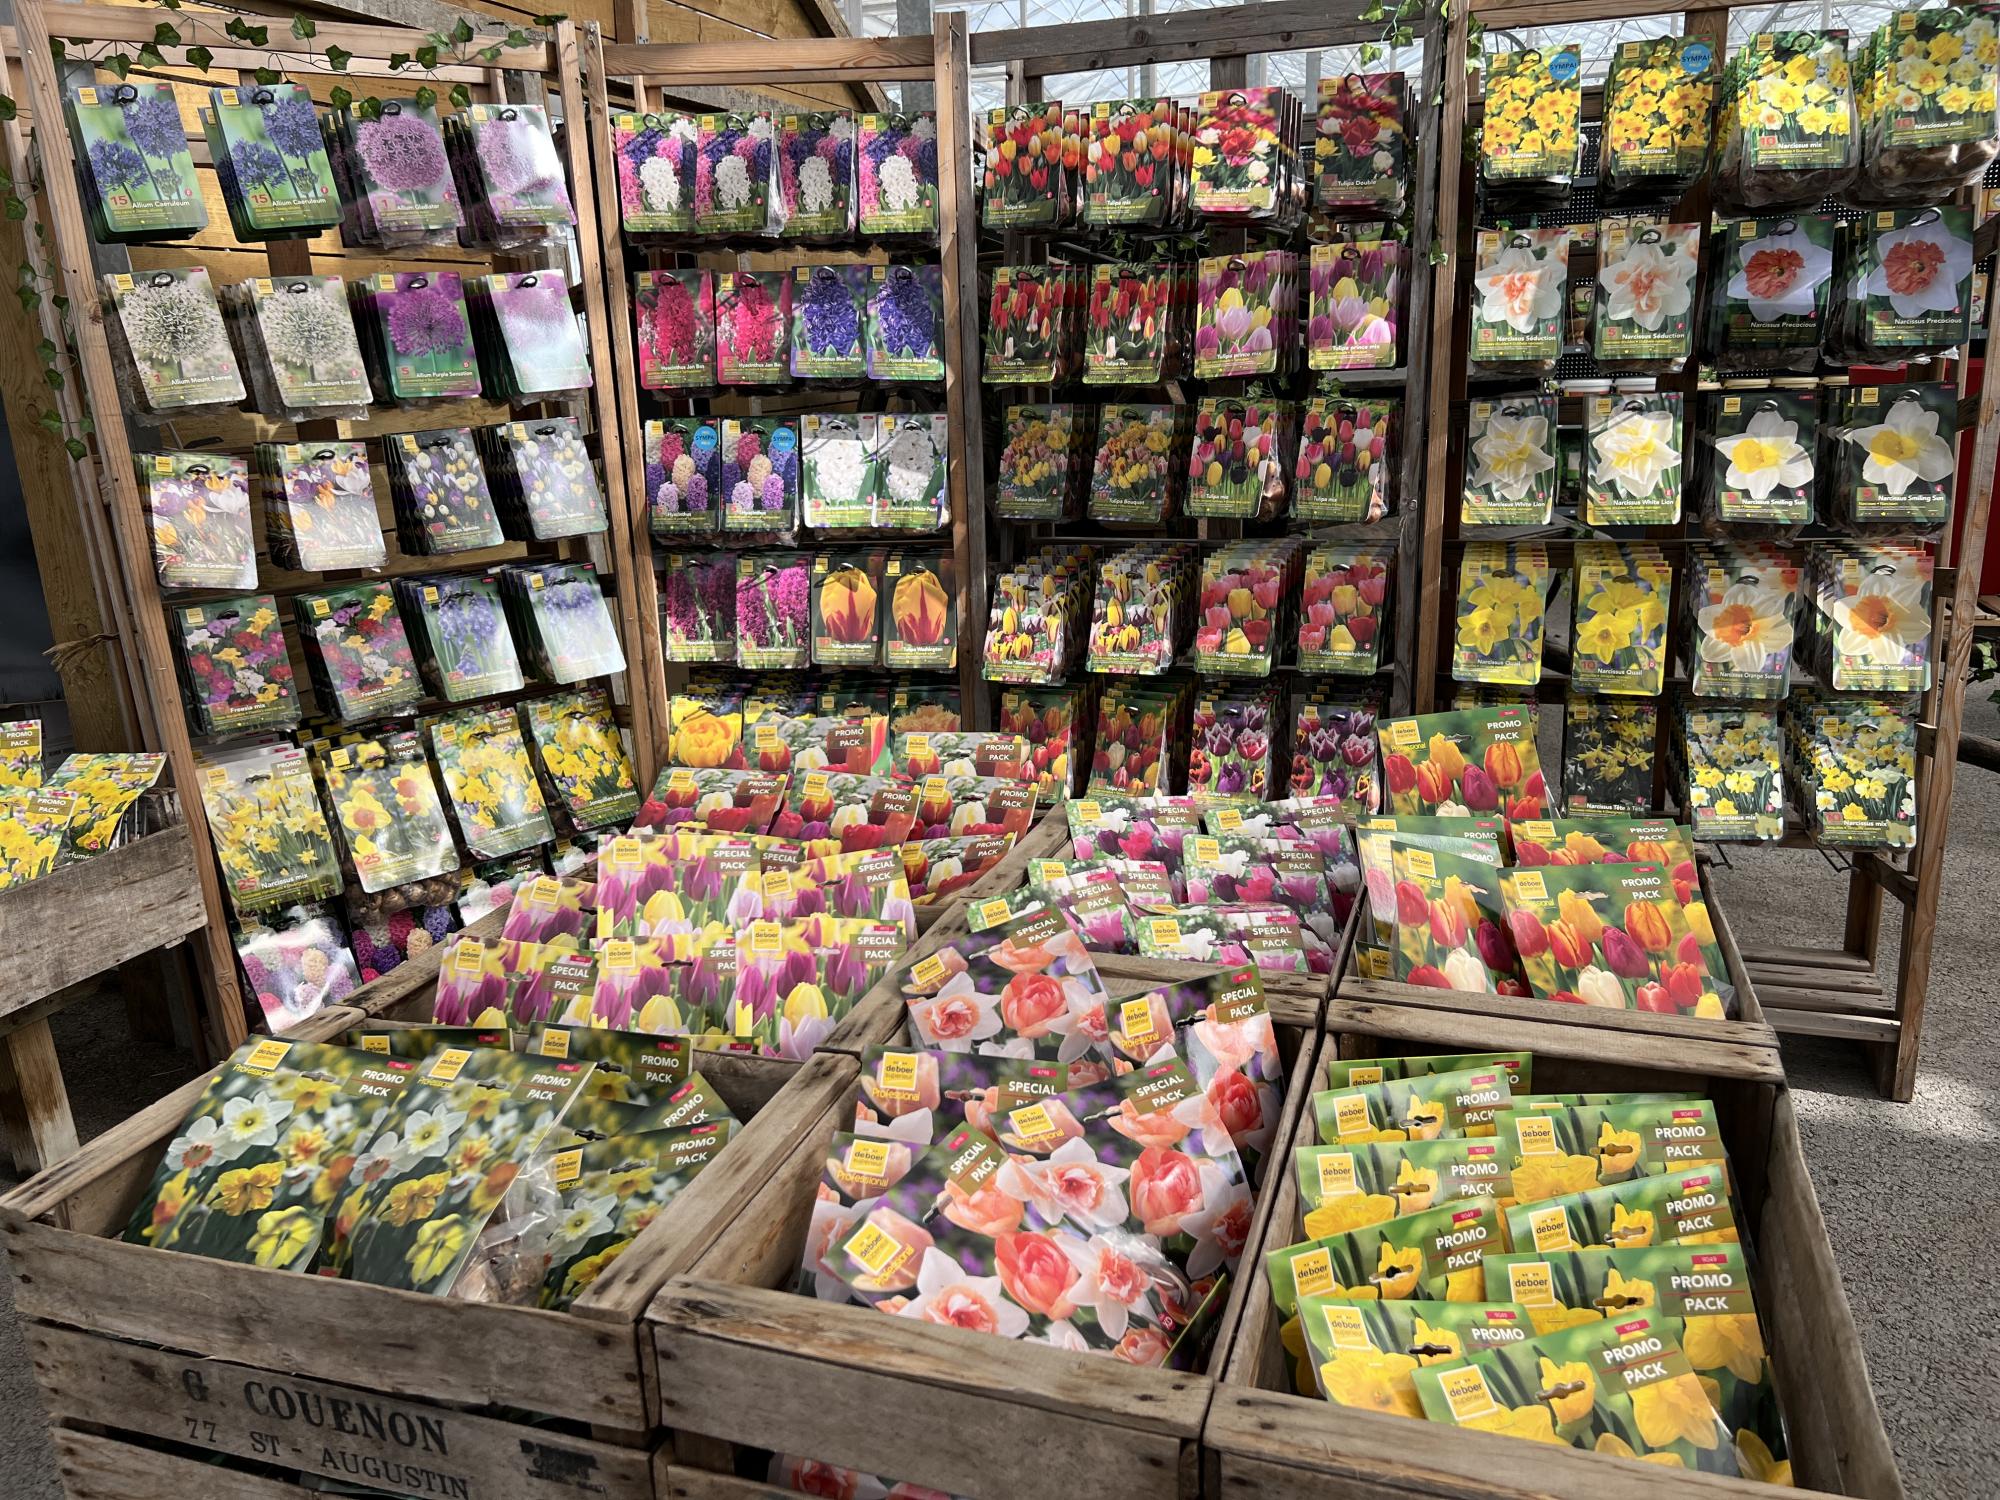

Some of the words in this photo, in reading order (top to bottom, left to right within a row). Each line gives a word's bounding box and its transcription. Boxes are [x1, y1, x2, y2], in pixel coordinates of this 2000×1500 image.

[110, 195, 128, 206] 15
[132, 201, 153, 209] Allium
[251, 194, 268, 204] 15
[1895, 317, 1925, 325] Narcissus
[1926, 317, 1962, 325] Precocious
[1525, 333, 1556, 341] Séduction
[1652, 331, 1685, 339] Séduction
[432, 371, 449, 379] Purple
[1908, 494, 1931, 502] Smiling
[1626, 668, 1643, 676] Quail
[1884, 664, 1904, 672] Orange
[1719, 671, 1743, 679] Narcissus
[1487, 719, 1522, 730] PROMO
[835, 727, 865, 738] PROMO
[1494, 731, 1519, 741] PACK
[839, 737, 861, 747] PACK
[985, 743, 1015, 753] PROMO
[989, 752, 1010, 762] PACK
[748, 779, 777, 789] PROMO
[749, 787, 771, 796] PACK
[882, 791, 912, 802] PROMO
[999, 788, 1029, 799] PROMO
[884, 801, 905, 813] PACK
[1001, 798, 1023, 809] PACK
[1158, 806, 1190, 816] SPECIAL
[1165, 815, 1186, 825] PACK
[975, 838, 1005, 850] PROMO
[712, 848, 752, 860] SPECIAL
[977, 847, 999, 858] PACK
[363, 854, 381, 865] 25
[720, 860, 747, 871] PACK
[857, 857, 897, 875] SPECIAL
[261, 877, 294, 889] Narcissus
[295, 873, 308, 881] mix
[866, 870, 892, 883] PACK
[1621, 877, 1661, 888] PROMO
[1632, 890, 1662, 900] PACK
[857, 935, 899, 948] SPECIAL
[864, 949, 892, 961] PACK
[550, 964, 590, 979] SPECIAL
[554, 979, 580, 993] PACK
[1220, 986, 1258, 1004] SPECIAL
[1230, 1004, 1257, 1019] PACK
[1120, 1033, 1160, 1050] Professional
[641, 1054, 679, 1068] PROMO
[362, 1069, 405, 1084] PROMO
[531, 1072, 571, 1087] PROMO
[645, 1072, 672, 1084] PACK
[359, 1084, 391, 1097] PACK
[1008, 1080, 1058, 1096] SPECIAL
[1135, 1073, 1185, 1098] SPECIAL
[526, 1089, 556, 1100] PACK
[872, 1087, 920, 1102] Professional
[1151, 1088, 1185, 1109] PACK
[1455, 1089, 1501, 1107] PROMO
[1464, 1109, 1496, 1124] PACK
[1654, 1124, 1707, 1139] PROMO
[670, 1136, 716, 1152] PROMO
[1015, 1129, 1065, 1149] Professional
[1665, 1144, 1703, 1158] PACK
[676, 1152, 708, 1165] PACK
[1450, 1162, 1499, 1177] PROMO
[837, 1170, 889, 1187] Professional
[1460, 1182, 1496, 1196] PACK
[1665, 1192, 1716, 1215] PROMO
[1678, 1215, 1715, 1233] PACK
[1435, 1226, 1488, 1251] PROMO
[874, 1243, 915, 1287] Professional
[1447, 1250, 1484, 1270] PACK
[1670, 1273, 1733, 1290] PROMO
[1684, 1296, 1728, 1311] PACK
[1471, 1327, 1525, 1343] PROMO
[1602, 1337, 1664, 1364] PROMO
[1623, 1360, 1668, 1385] PACK
[243, 1381, 450, 1456] COUENON
[184, 1416, 217, 1443] 77
[250, 1431, 281, 1457] ST
[321, 1447, 470, 1500] AUGUSTIN
